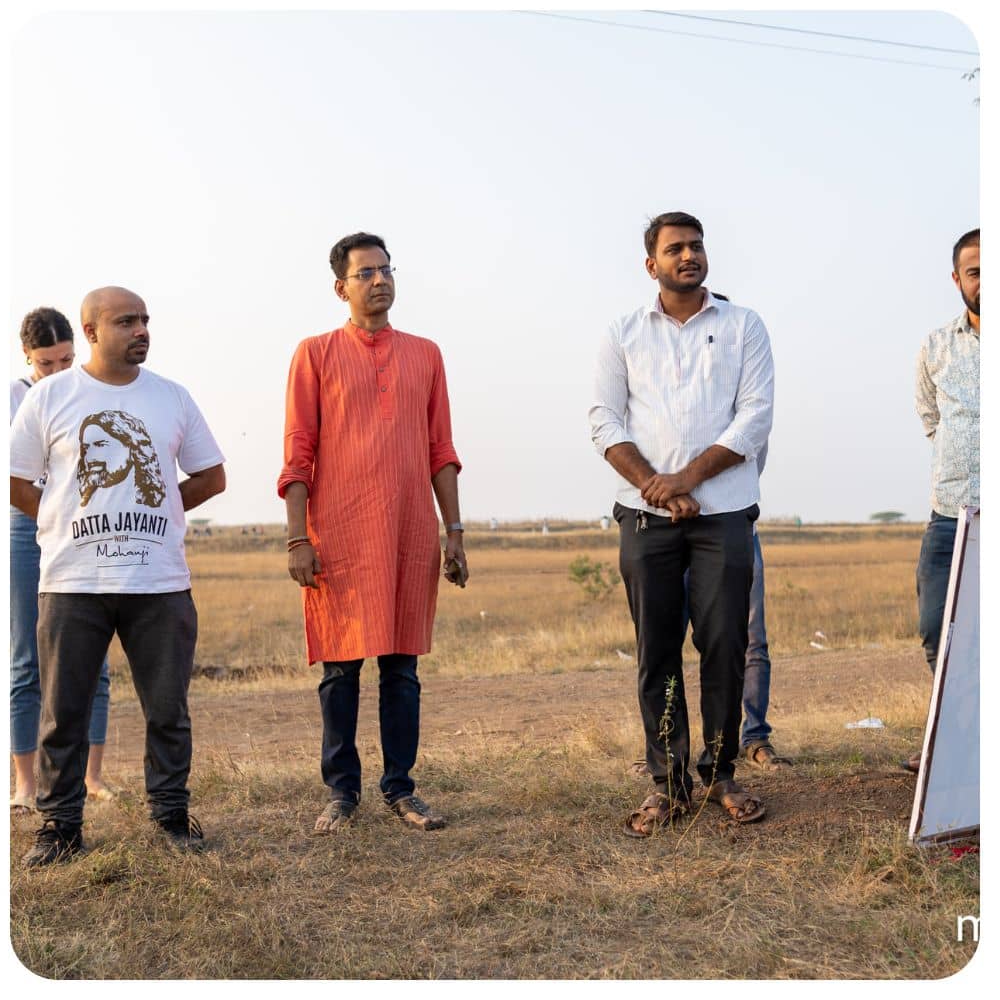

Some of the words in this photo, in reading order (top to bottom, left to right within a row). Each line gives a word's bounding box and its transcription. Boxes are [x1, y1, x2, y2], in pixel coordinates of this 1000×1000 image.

[72, 513, 111, 539] DATTA
[114, 511, 169, 537] JAYANTI
[113, 534, 129, 542] WITH
[96, 543, 150, 564] Mohanji
